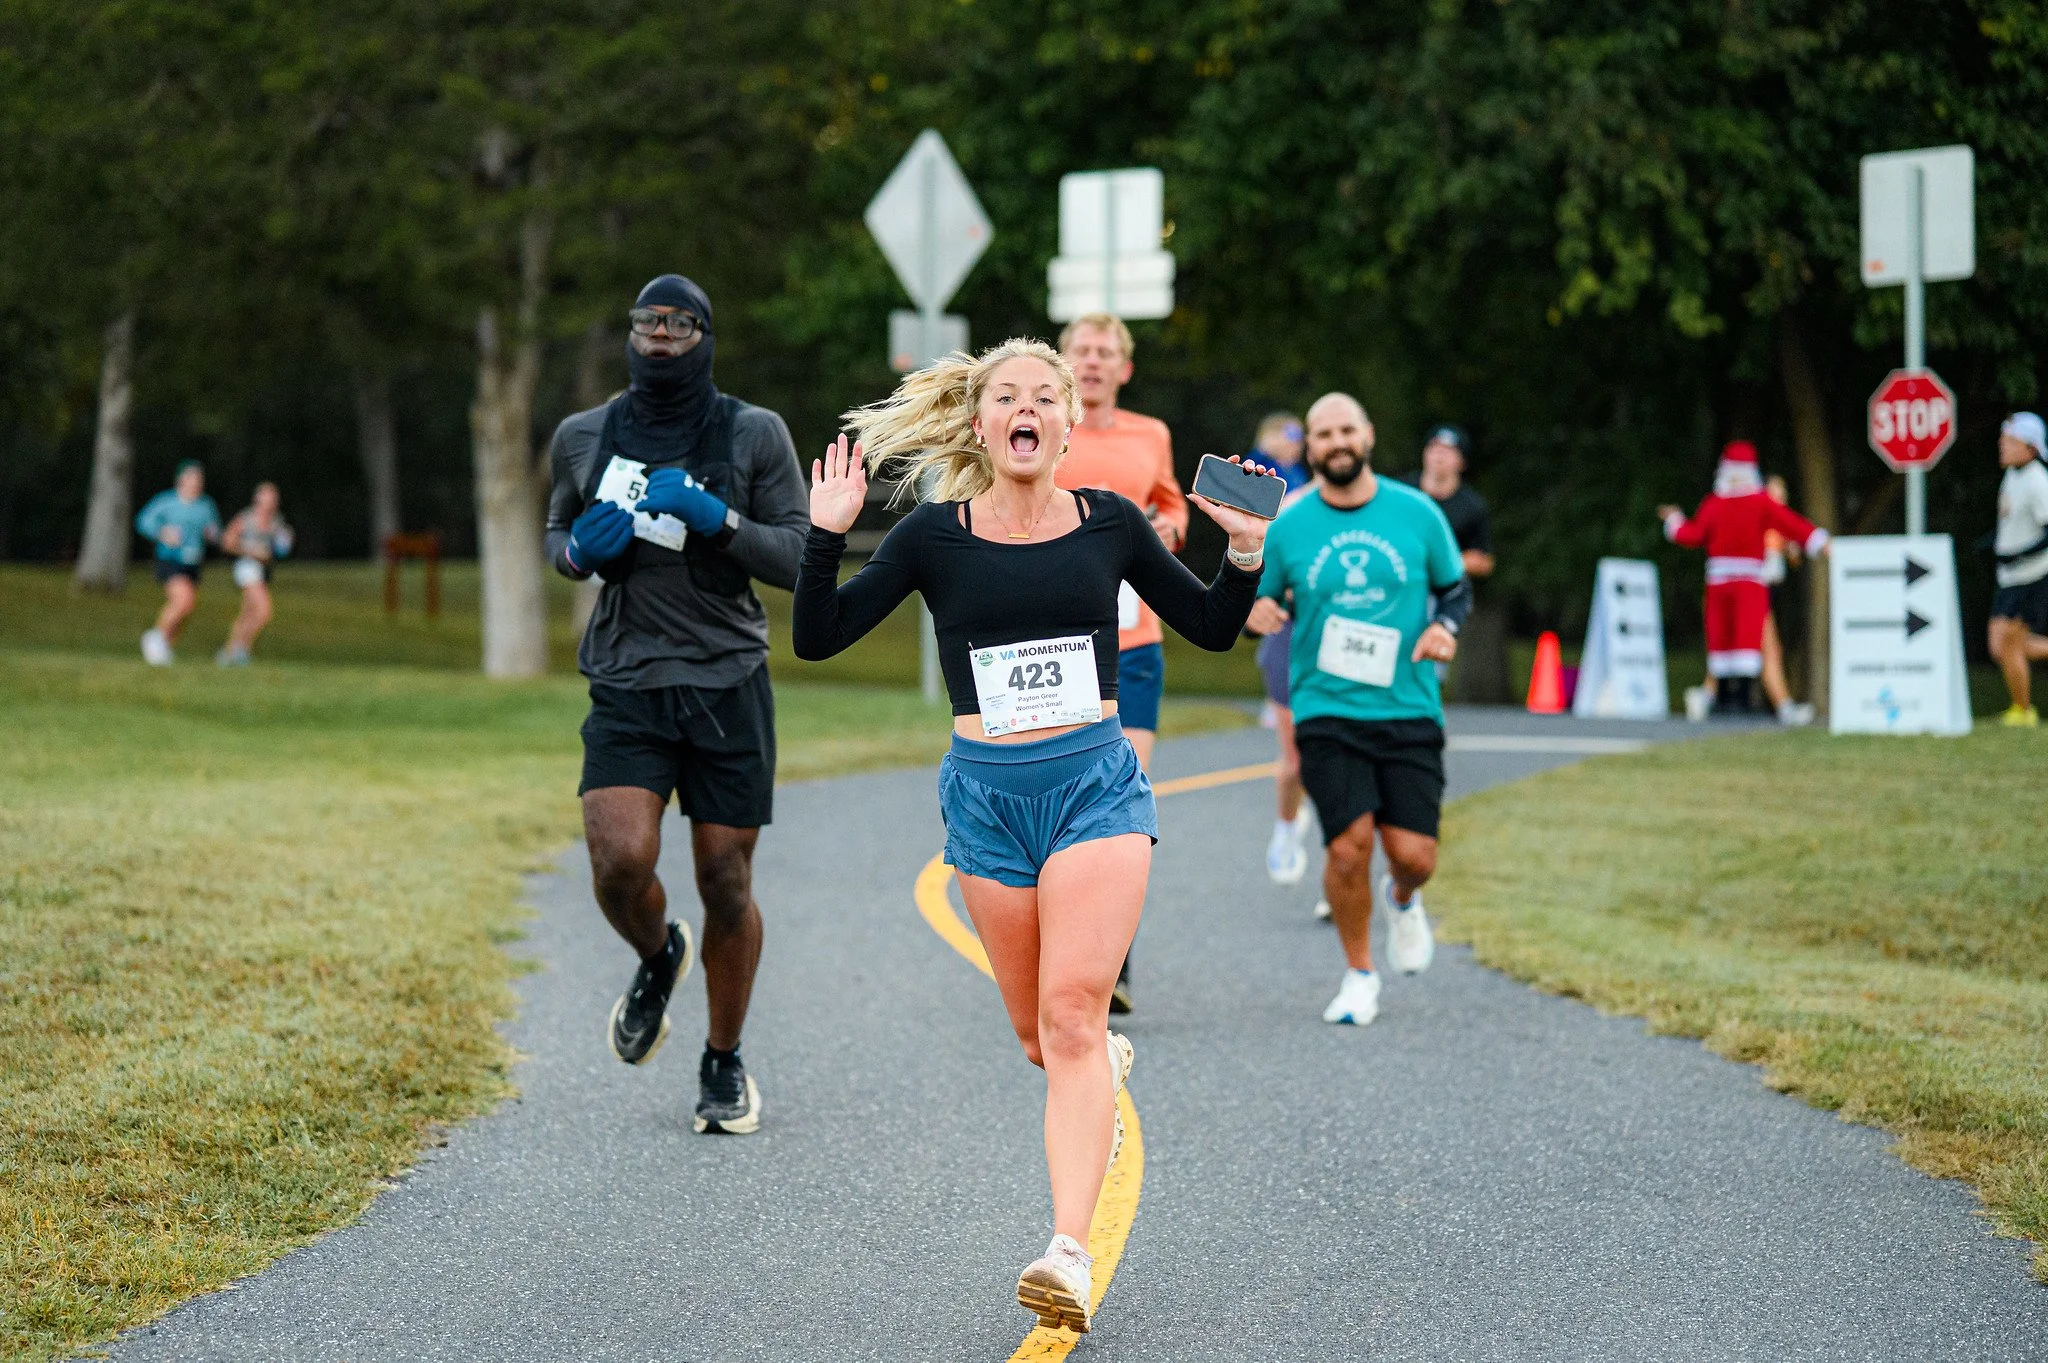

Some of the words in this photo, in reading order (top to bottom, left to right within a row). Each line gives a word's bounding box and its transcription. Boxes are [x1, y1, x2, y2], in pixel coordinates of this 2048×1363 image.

[1873, 397, 1951, 443] STOP
[1000, 650, 1016, 661] VA
[1018, 642, 1087, 658] MOMENTUM
[1008, 661, 1063, 691] 423
[1016, 703, 1044, 711] Women's
[1045, 700, 1063, 708] Small
